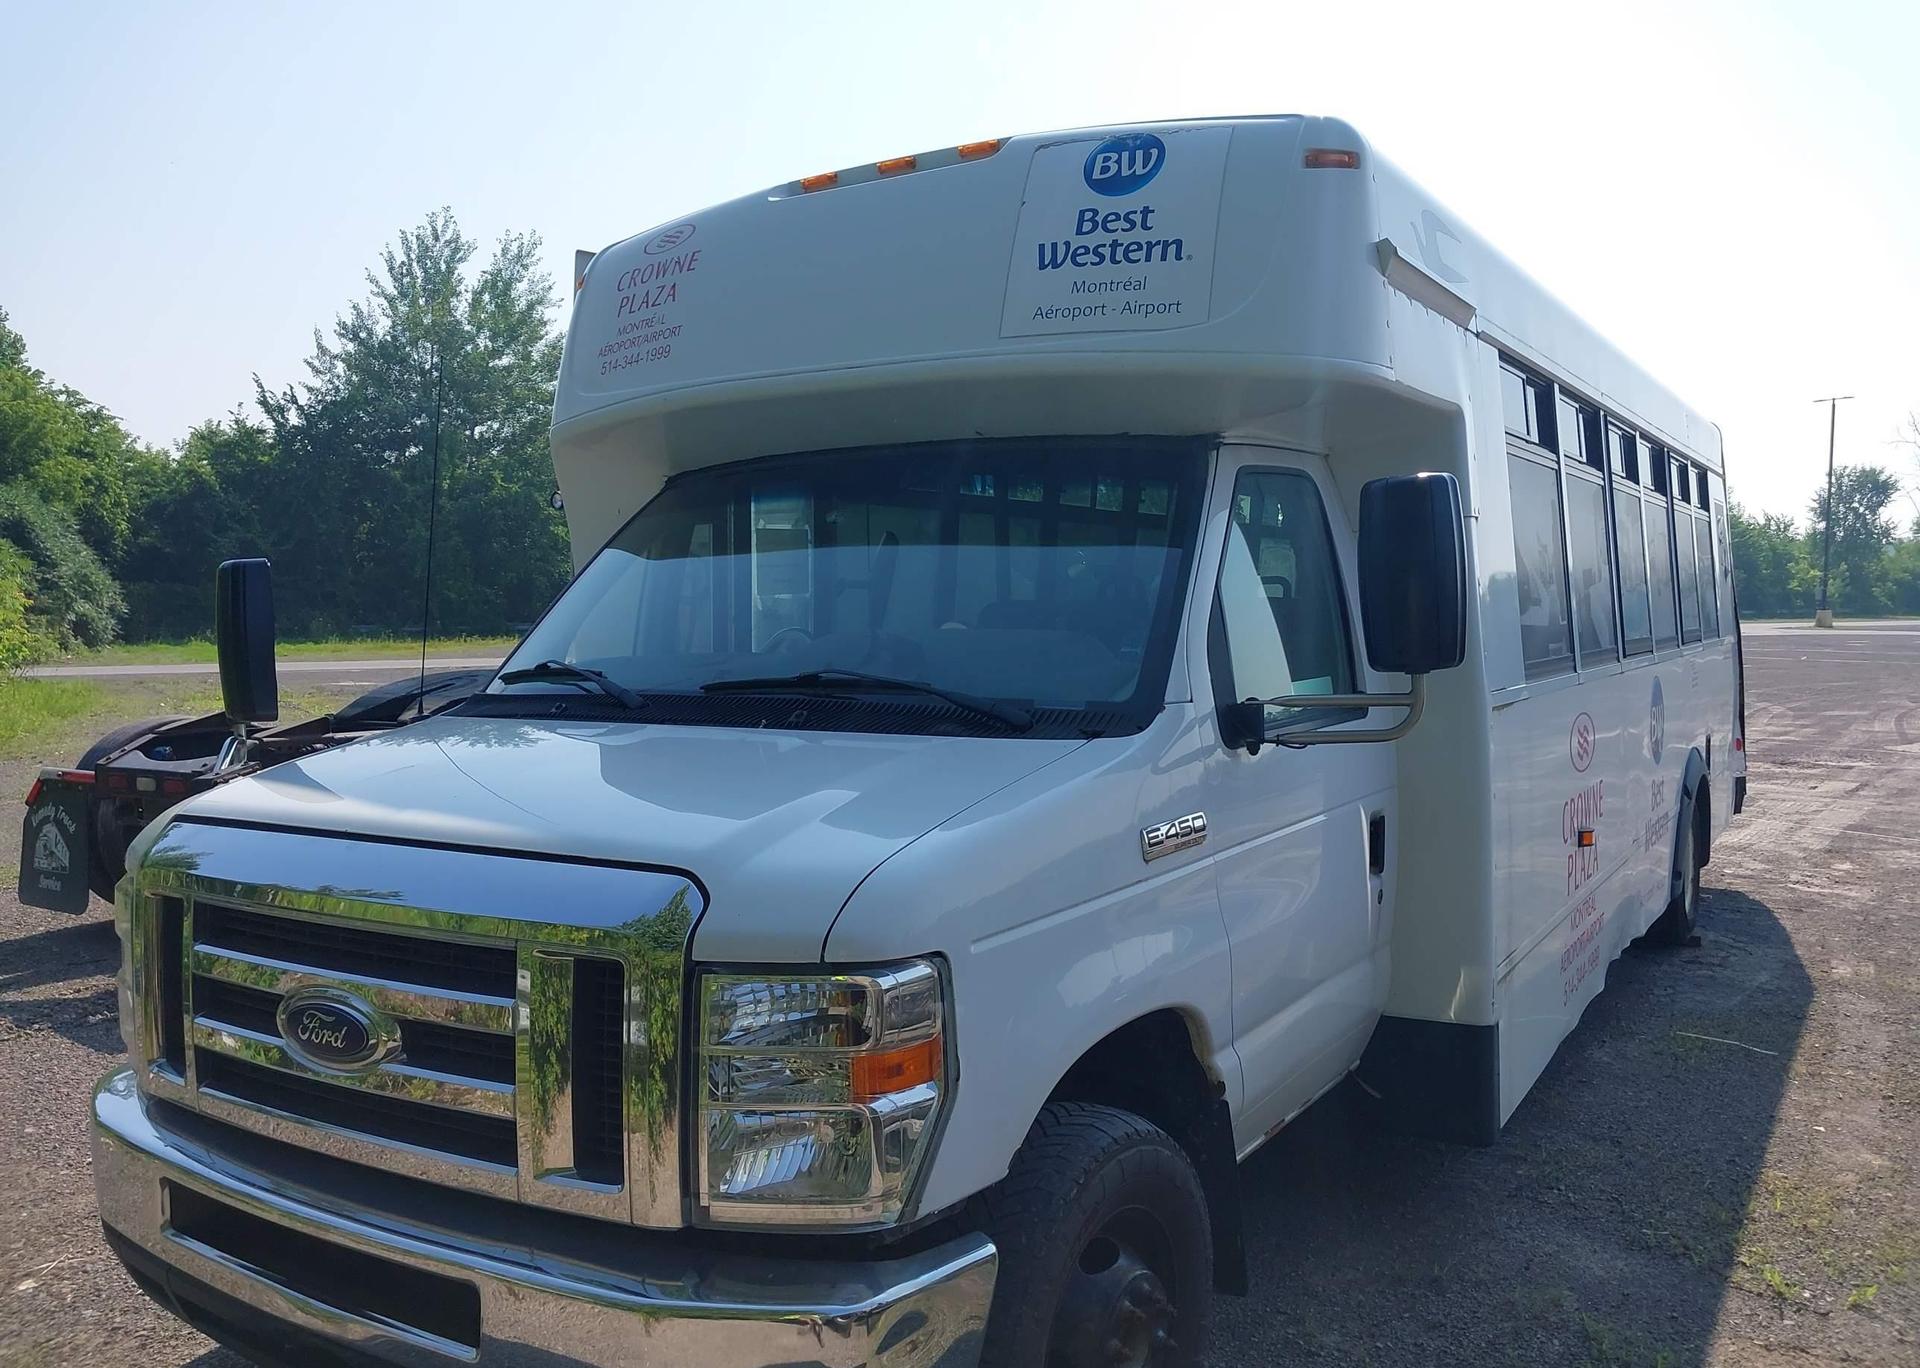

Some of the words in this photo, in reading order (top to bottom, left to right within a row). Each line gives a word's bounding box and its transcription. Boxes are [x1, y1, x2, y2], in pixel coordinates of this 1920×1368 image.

[1092, 147, 1158, 180] BW
[1075, 205, 1155, 236] Best
[616, 250, 702, 292] CROWNE
[1071, 275, 1148, 295] Montréal
[617, 282, 677, 318] PLAZA
[1032, 302, 1107, 321] Aéroport
[1120, 299, 1182, 318] Airport
[600, 344, 671, 376] 514-344-1999
[1651, 775, 1664, 812] Best
[1562, 779, 1604, 845] CROWNE
[1567, 834, 1599, 896] PLAZA
[298, 1010, 348, 1048] Ford
